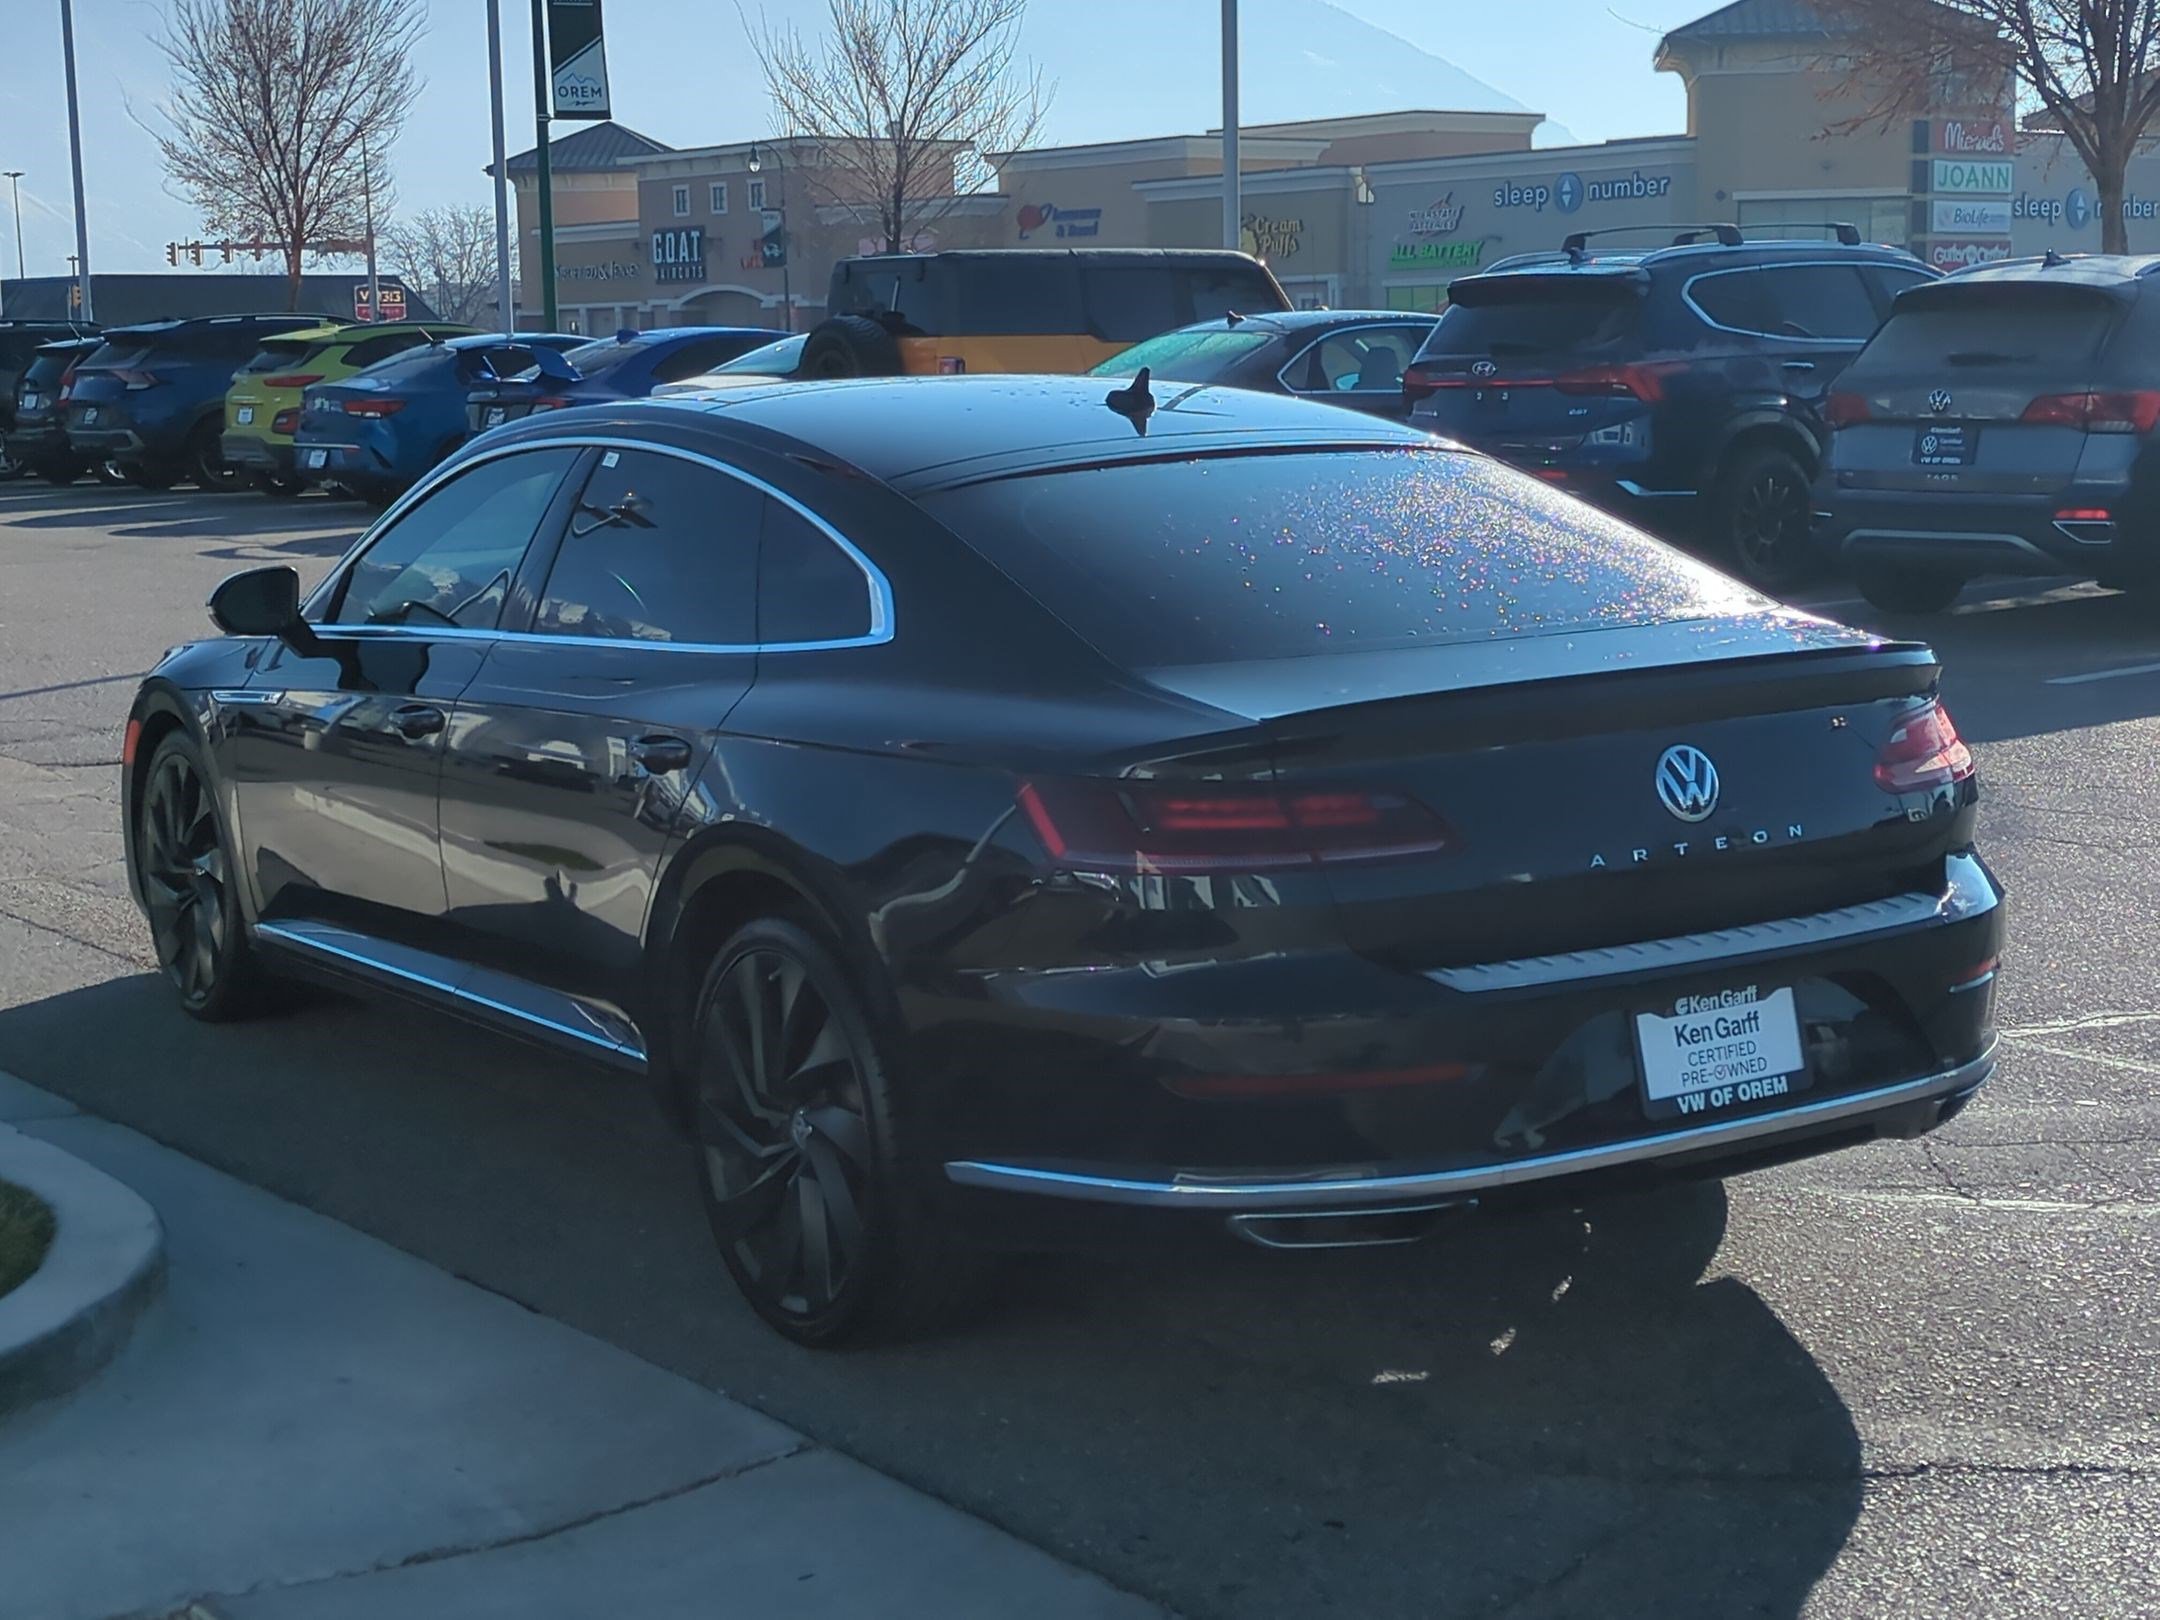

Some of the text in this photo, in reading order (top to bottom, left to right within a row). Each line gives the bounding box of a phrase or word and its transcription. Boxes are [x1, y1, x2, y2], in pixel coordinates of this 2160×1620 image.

[558, 86, 602, 98] OREM
[1939, 165, 2009, 188] JOANN
[1494, 173, 1669, 211] sleep number
[2014, 192, 2159, 224] sleep nmber
[1255, 216, 1302, 234] Cream
[1260, 233, 1297, 257] Puffs
[1590, 824, 1804, 868] ARTEON
[1689, 985, 1758, 1014] Ken Garff
[1674, 1010, 1760, 1048] Ken Garff
[1688, 1040, 1757, 1067] CERTIFIED
[1677, 1075, 1788, 1114] VW OF OREM
